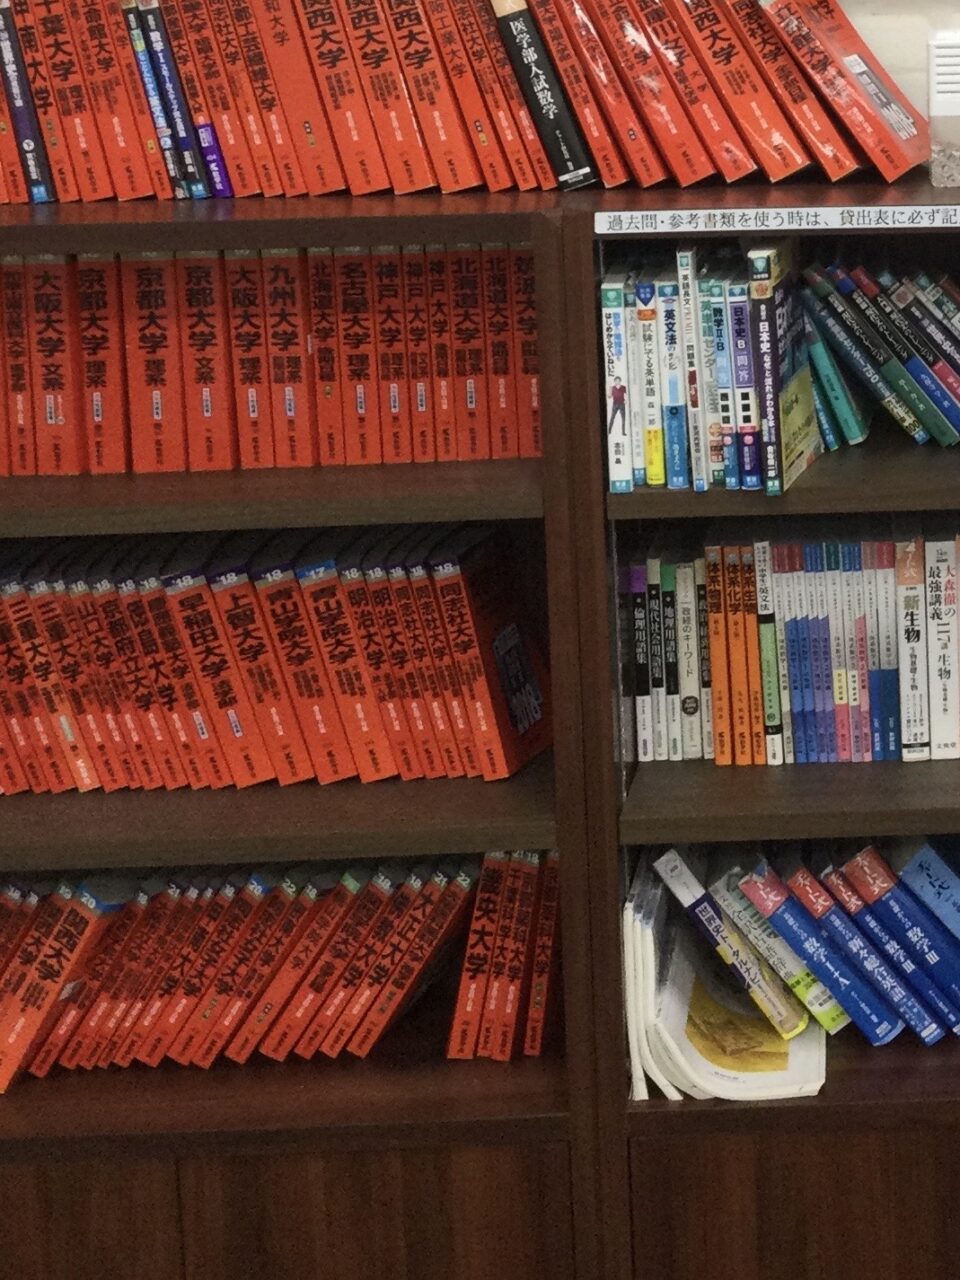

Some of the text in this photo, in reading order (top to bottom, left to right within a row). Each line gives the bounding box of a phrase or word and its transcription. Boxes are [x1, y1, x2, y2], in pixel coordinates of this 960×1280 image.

[33, 271, 66, 359] 大阪大学
[185, 265, 218, 352] 京都大学
[231, 265, 263, 353] 大阪大学
[268, 263, 302, 352] 九州大学
[377, 261, 404, 348] 神戸大学
[405, 261, 427, 347] 神戸大学
[429, 260, 449, 338] 神戸大学
[734, 307, 746, 349] 日本史B
[759, 321, 771, 354] 日本史
[225, 592, 269, 663] 上智大学
[347, 587, 387, 671] 明治大学
[372, 587, 410, 670] 明治大学
[439, 582, 476, 656] 同志社大学
[726, 562, 742, 615] 体系化学
[927, 566, 942, 621] 最強講義
[943, 564, 956, 618] 大森徹の
[178, 592, 231, 679] 早稲田大学
[35, 906, 89, 983] 関西大学
[697, 903, 759, 984] 世界史トータルナビ
